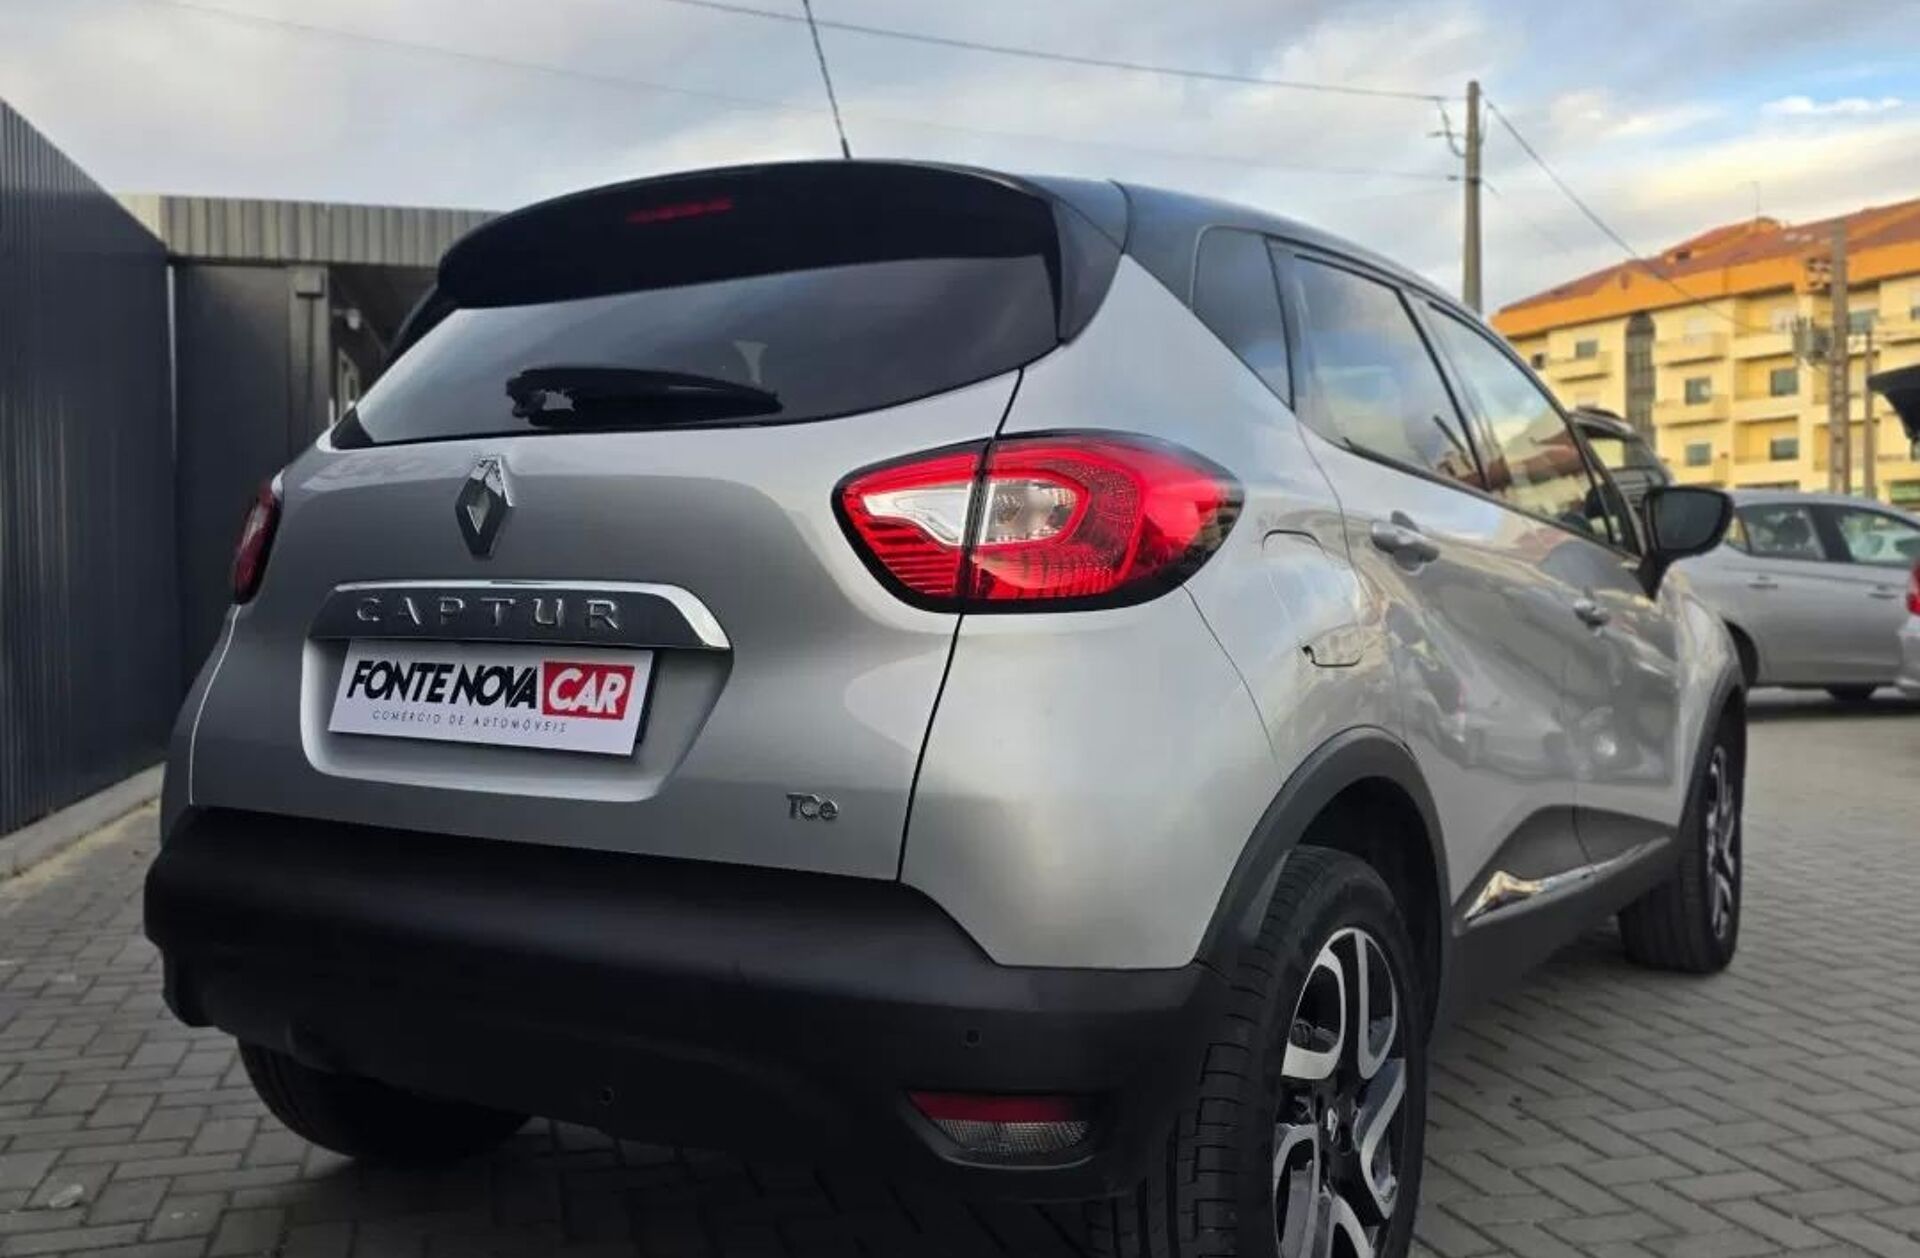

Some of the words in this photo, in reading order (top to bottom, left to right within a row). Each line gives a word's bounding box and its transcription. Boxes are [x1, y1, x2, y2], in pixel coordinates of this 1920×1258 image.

[357, 597, 624, 630] CAPTUR
[548, 668, 626, 714] CAR
[449, 715, 465, 727] DE
[786, 792, 838, 820] TCe
